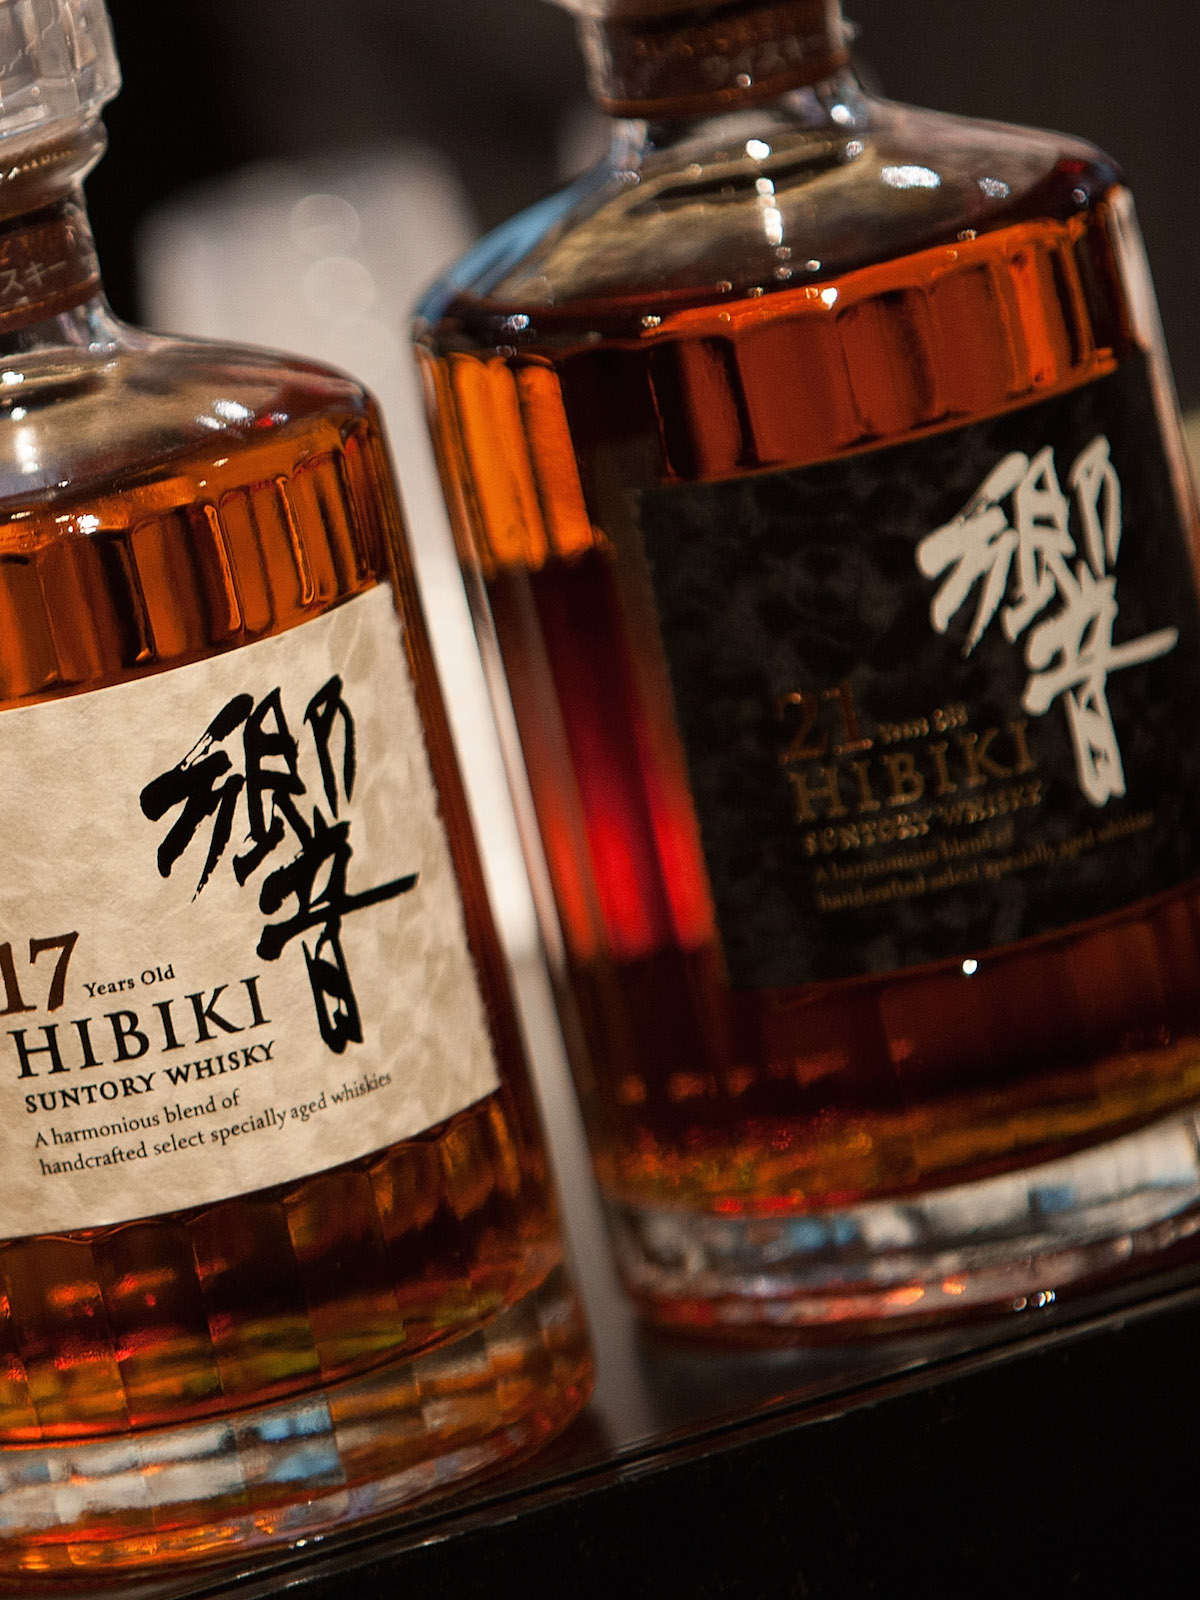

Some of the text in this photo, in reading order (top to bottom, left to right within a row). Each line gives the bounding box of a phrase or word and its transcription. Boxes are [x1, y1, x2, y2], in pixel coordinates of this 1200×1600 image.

[915, 434, 1179, 807] 響
[776, 682, 873, 765] 21
[787, 718, 1037, 824] HIBIKI
[139, 674, 420, 1054] 響
[803, 808, 932, 856] SUNTORY
[7, 975, 271, 1079] HIBIKI
[83, 976, 135, 998] Years
[141, 965, 175, 985] Old
[25, 1041, 275, 1113] SUNTORY WHISKY
[35, 1089, 241, 1149] A harmonious blend of
[39, 1070, 392, 1176] handcrafted select specially aged whiskies
